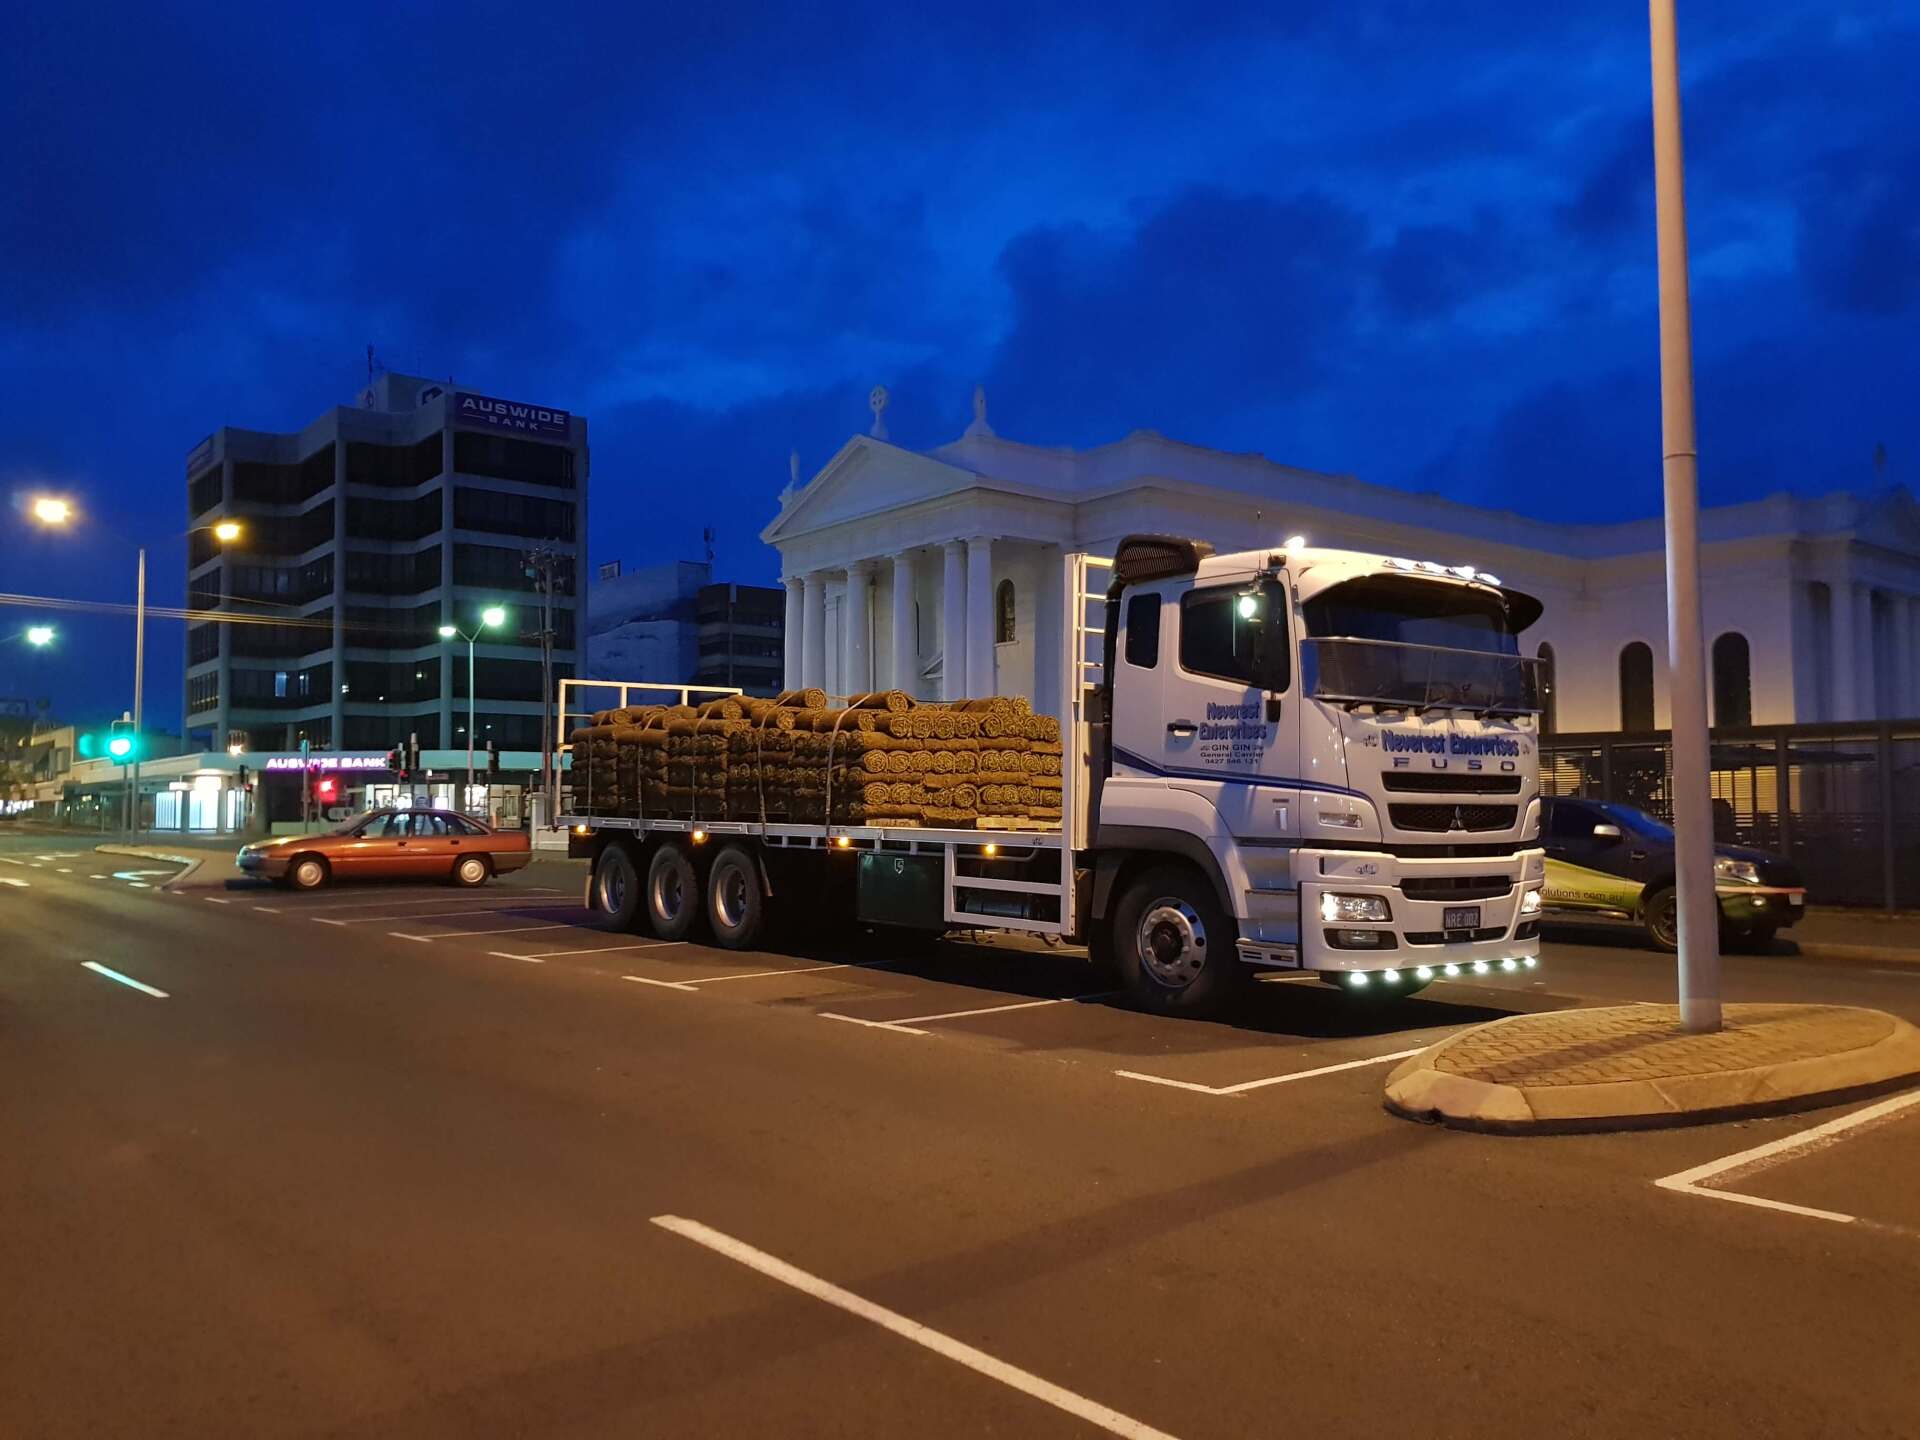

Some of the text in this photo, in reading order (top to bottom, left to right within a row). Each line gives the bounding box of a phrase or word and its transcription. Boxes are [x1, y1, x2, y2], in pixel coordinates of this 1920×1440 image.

[462, 398, 565, 425] AUSWIDE
[488, 415, 539, 431] BANK
[1206, 702, 1260, 720] Neverest
[1199, 722, 1267, 741] Enterprises
[1381, 729, 1520, 758] Neverest Enterprises
[341, 758, 385, 768] BANK
[1393, 757, 1516, 771] FUSO
